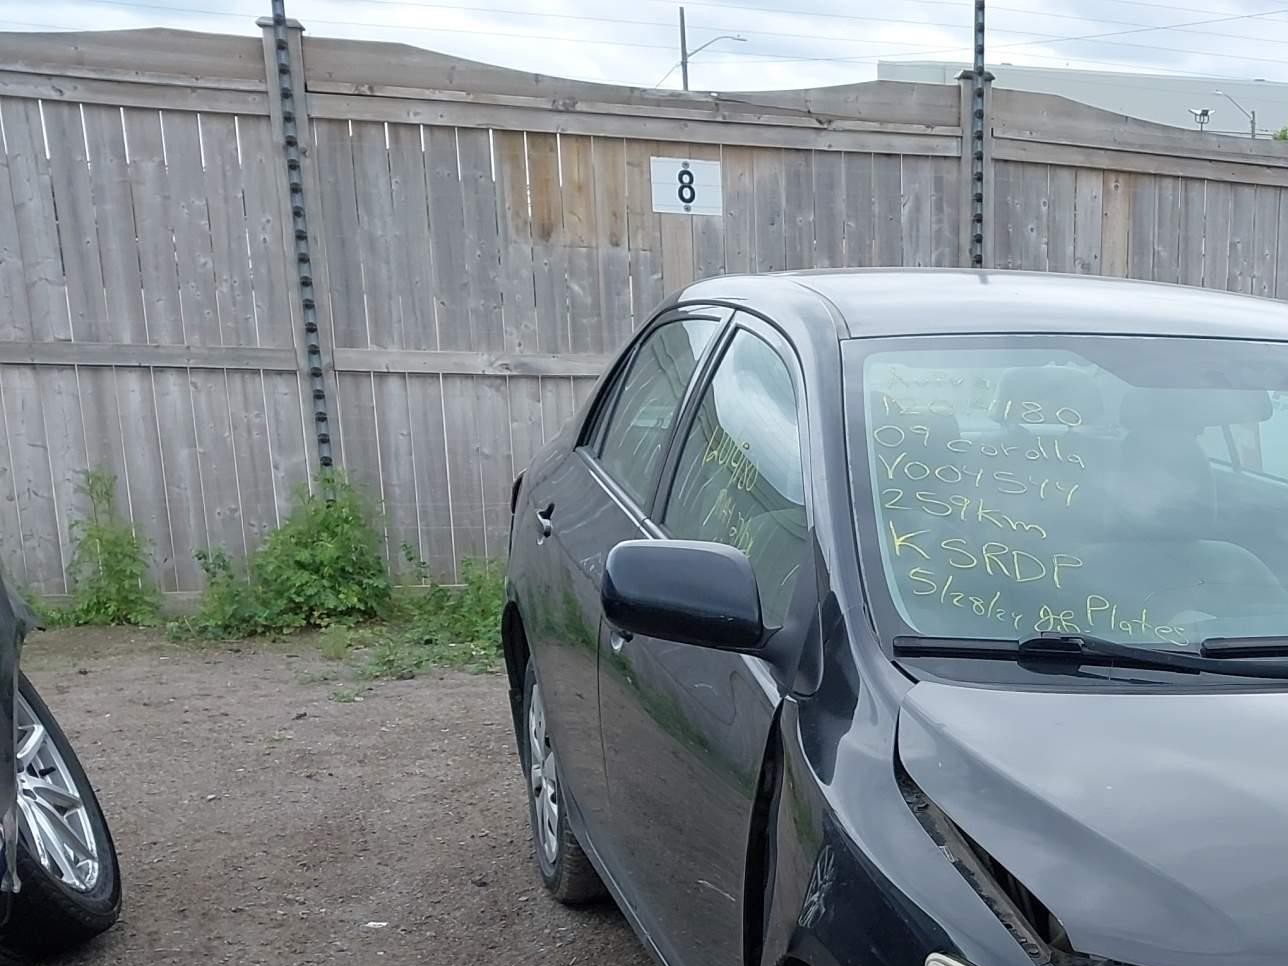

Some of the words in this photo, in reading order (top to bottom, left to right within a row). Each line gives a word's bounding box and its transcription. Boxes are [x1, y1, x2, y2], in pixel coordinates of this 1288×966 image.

[677, 169, 696, 204] 8
[873, 424, 930, 448] 09
[1086, 594, 1190, 647] Plates
